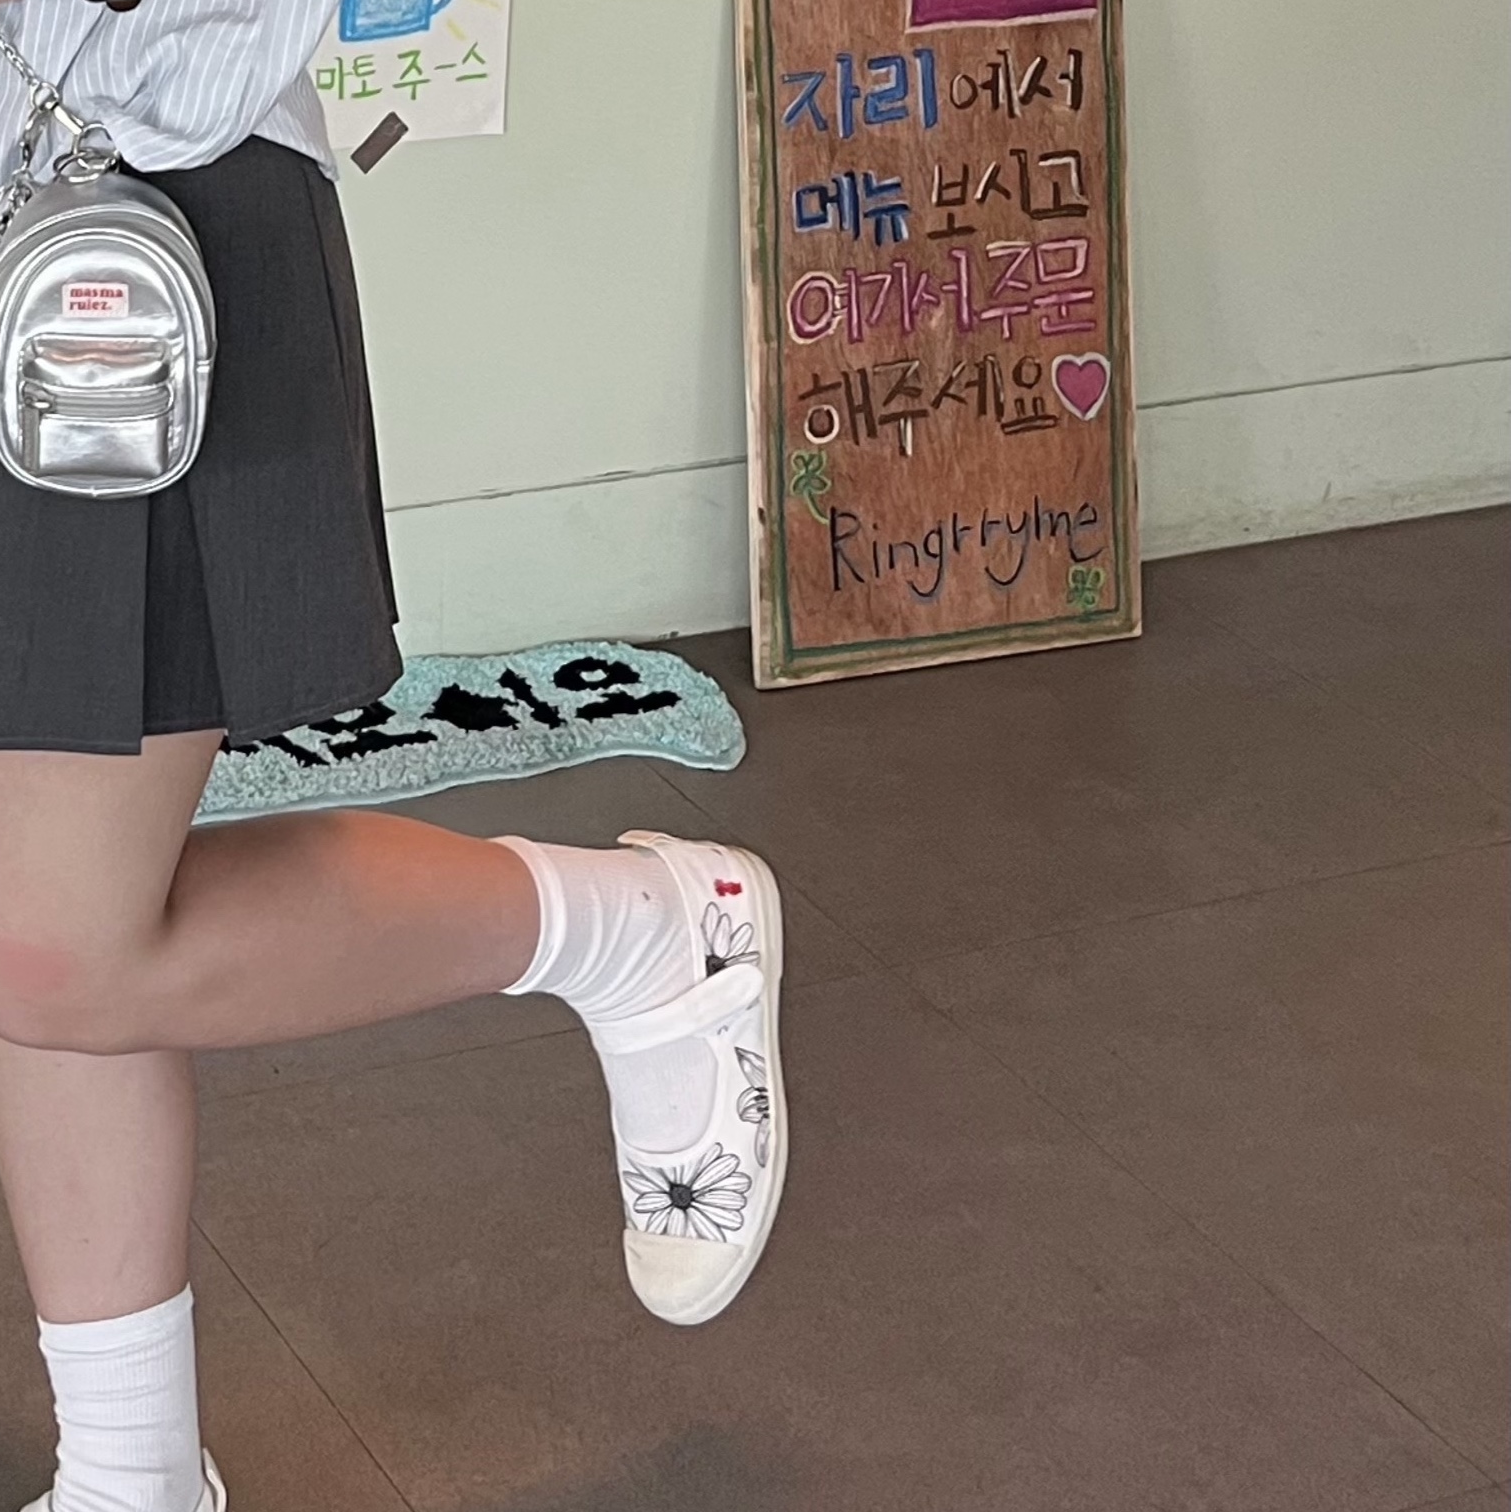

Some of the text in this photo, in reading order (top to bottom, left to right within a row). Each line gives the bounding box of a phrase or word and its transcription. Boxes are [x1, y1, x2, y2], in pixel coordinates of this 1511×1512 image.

[793, 148, 1089, 247] 메뉴 보시고
[797, 354, 1059, 457] 해주세요
